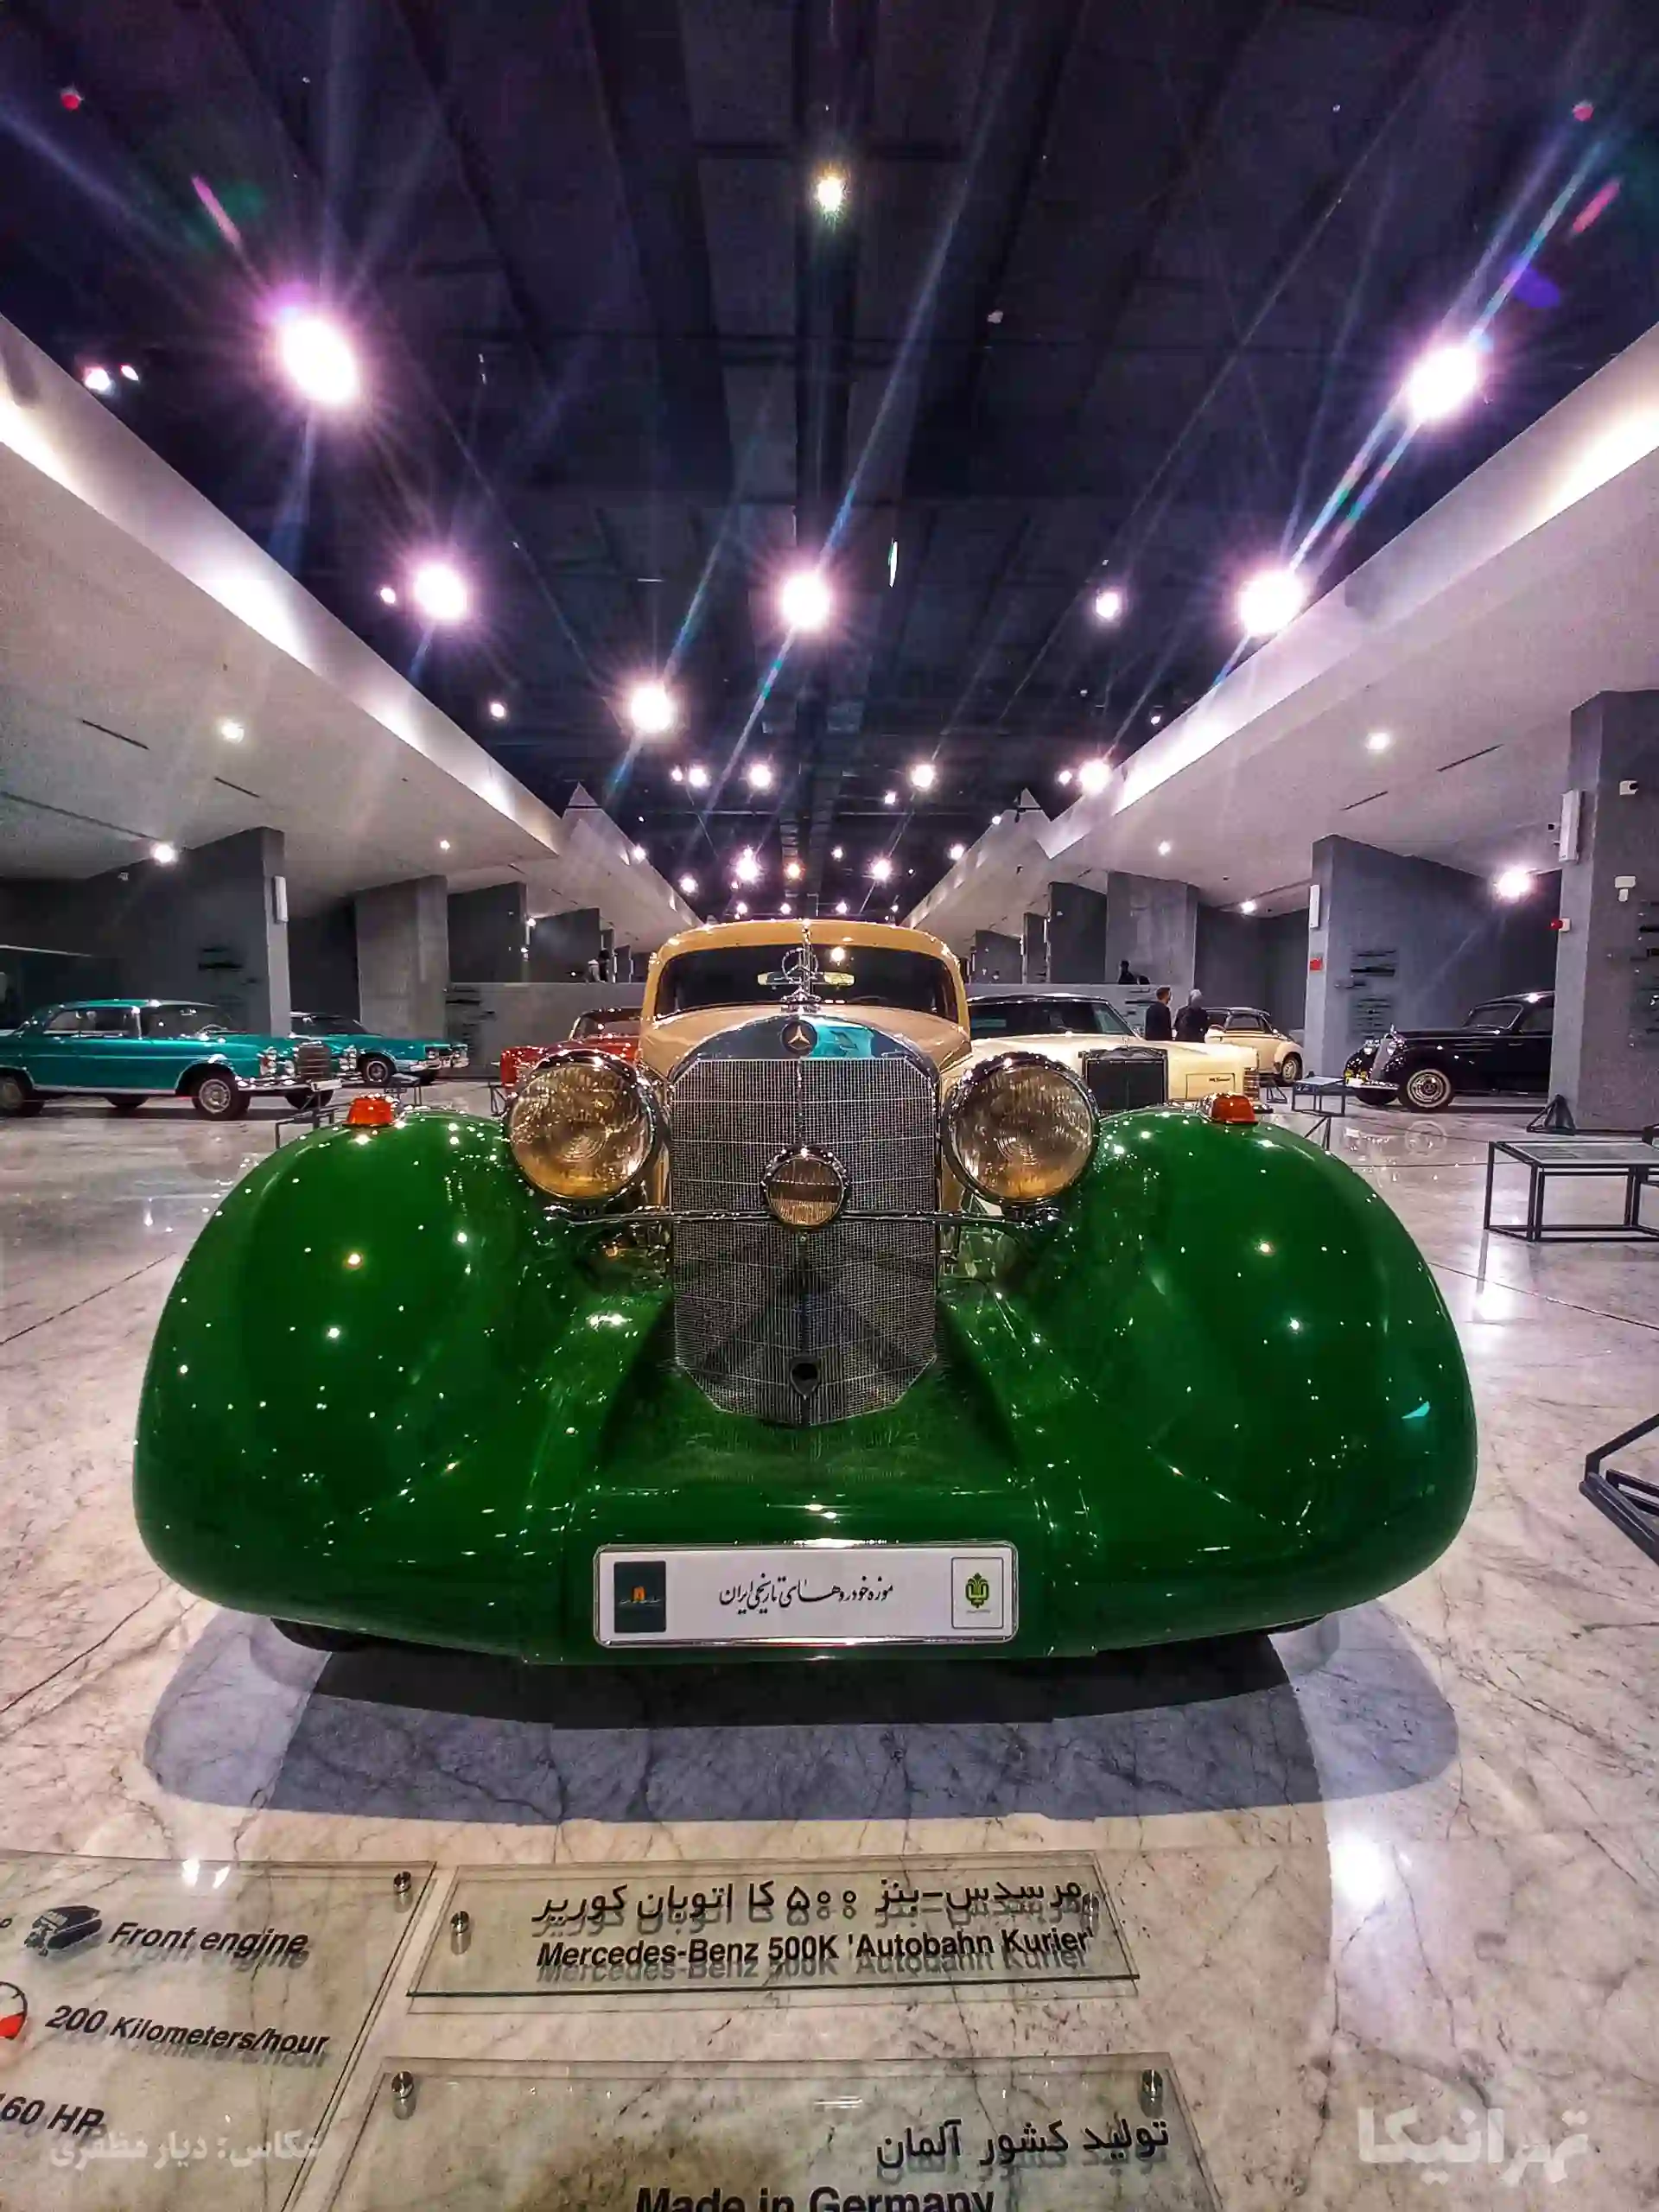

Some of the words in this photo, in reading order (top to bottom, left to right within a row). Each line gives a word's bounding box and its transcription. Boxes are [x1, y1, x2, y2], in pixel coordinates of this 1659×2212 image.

[719, 1580, 754, 1615] ایران
[867, 1575, 894, 1602] موزه
[531, 1884, 628, 1923] کوریر
[636, 1883, 734, 1920] اتوبان
[747, 1879, 775, 1906] کا
[107, 1922, 198, 1948] Front
[200, 1928, 309, 1959] engine
[536, 1939, 760, 1967] Mercedes-Benz
[767, 1934, 838, 1961] 500K
[44, 2005, 109, 2034] 200
[109, 2016, 331, 2056] Kilometers/hour
[47, 2103, 105, 2135] HP
[876, 2118, 963, 2169] آلمان
[978, 2120, 1070, 2166] کشور
[1082, 2118, 1169, 2159] تولید
